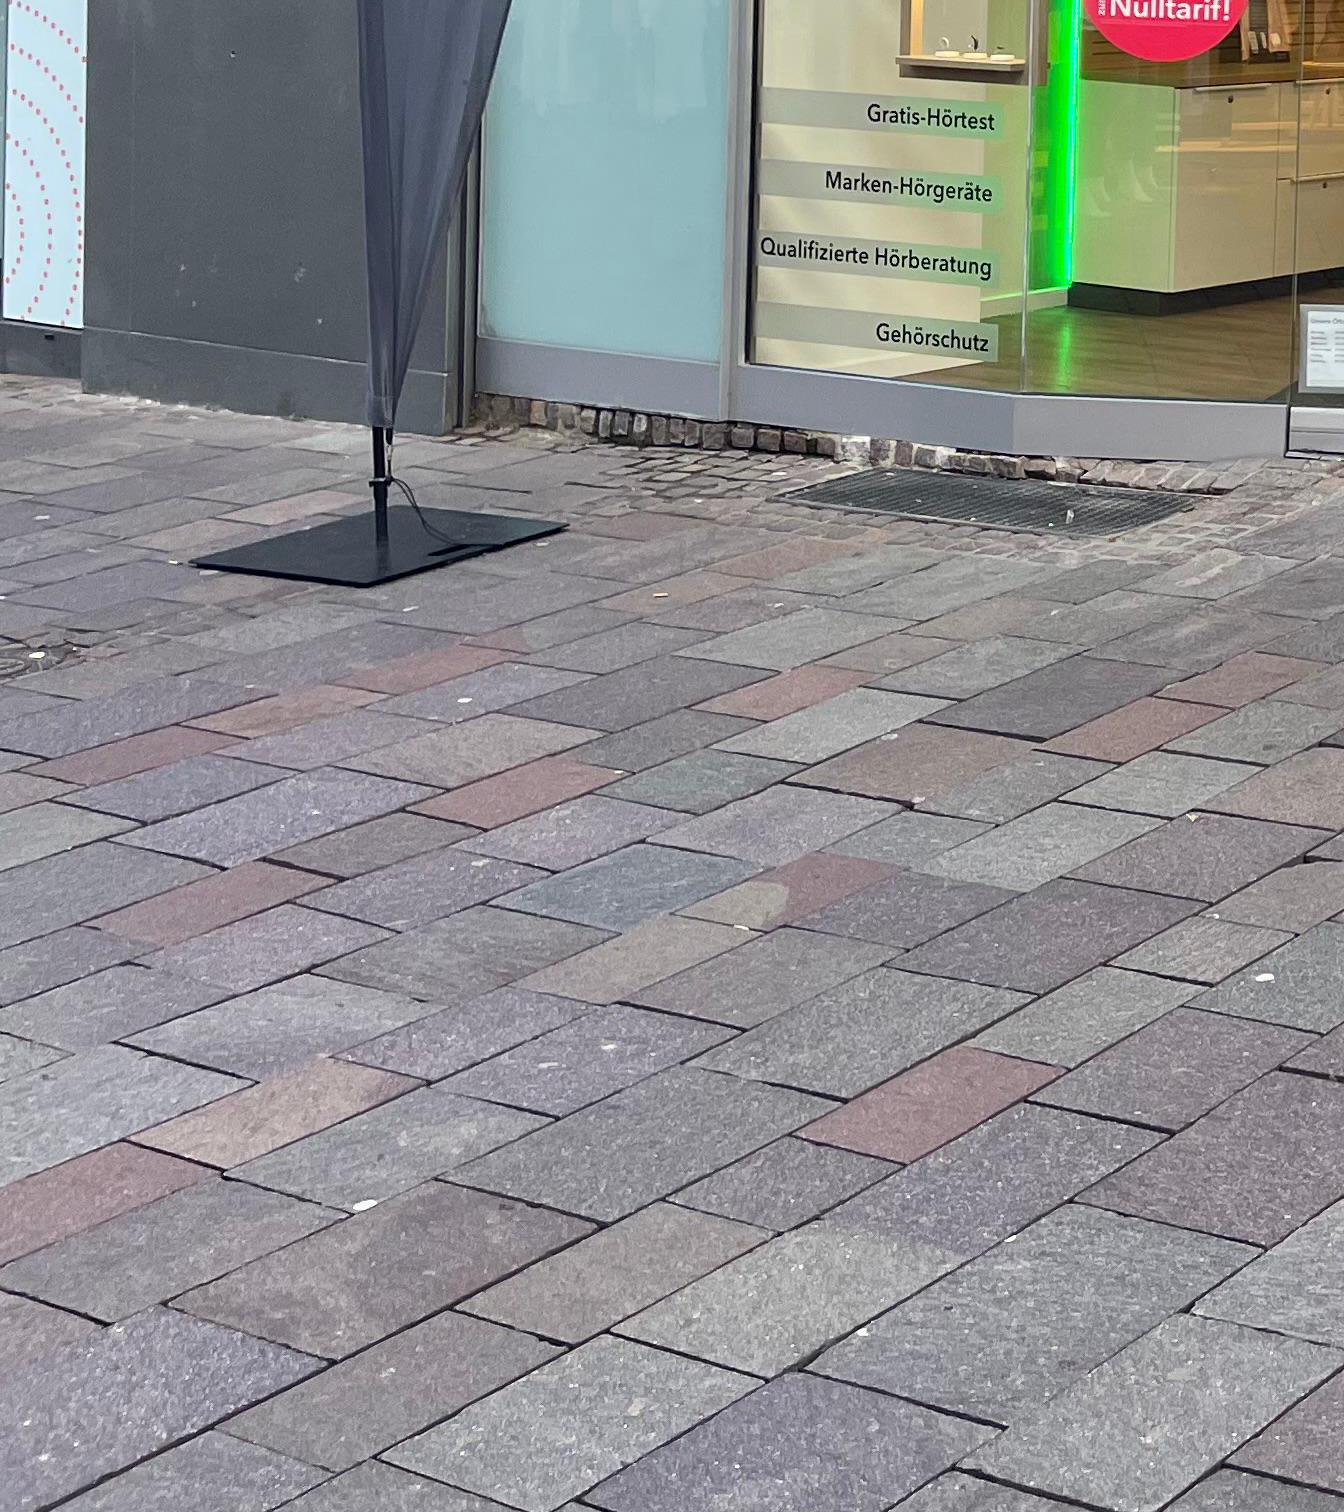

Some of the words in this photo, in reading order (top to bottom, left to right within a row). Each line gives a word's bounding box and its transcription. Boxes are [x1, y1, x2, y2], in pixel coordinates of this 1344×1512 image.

[866, 103, 996, 131] Gratis-Hörtest
[825, 170, 994, 204] Marken-Hörgeräte
[760, 236, 869, 265] Qualifizierte
[874, 247, 993, 282] Hörberatung
[875, 322, 990, 353] Gehörschutz
